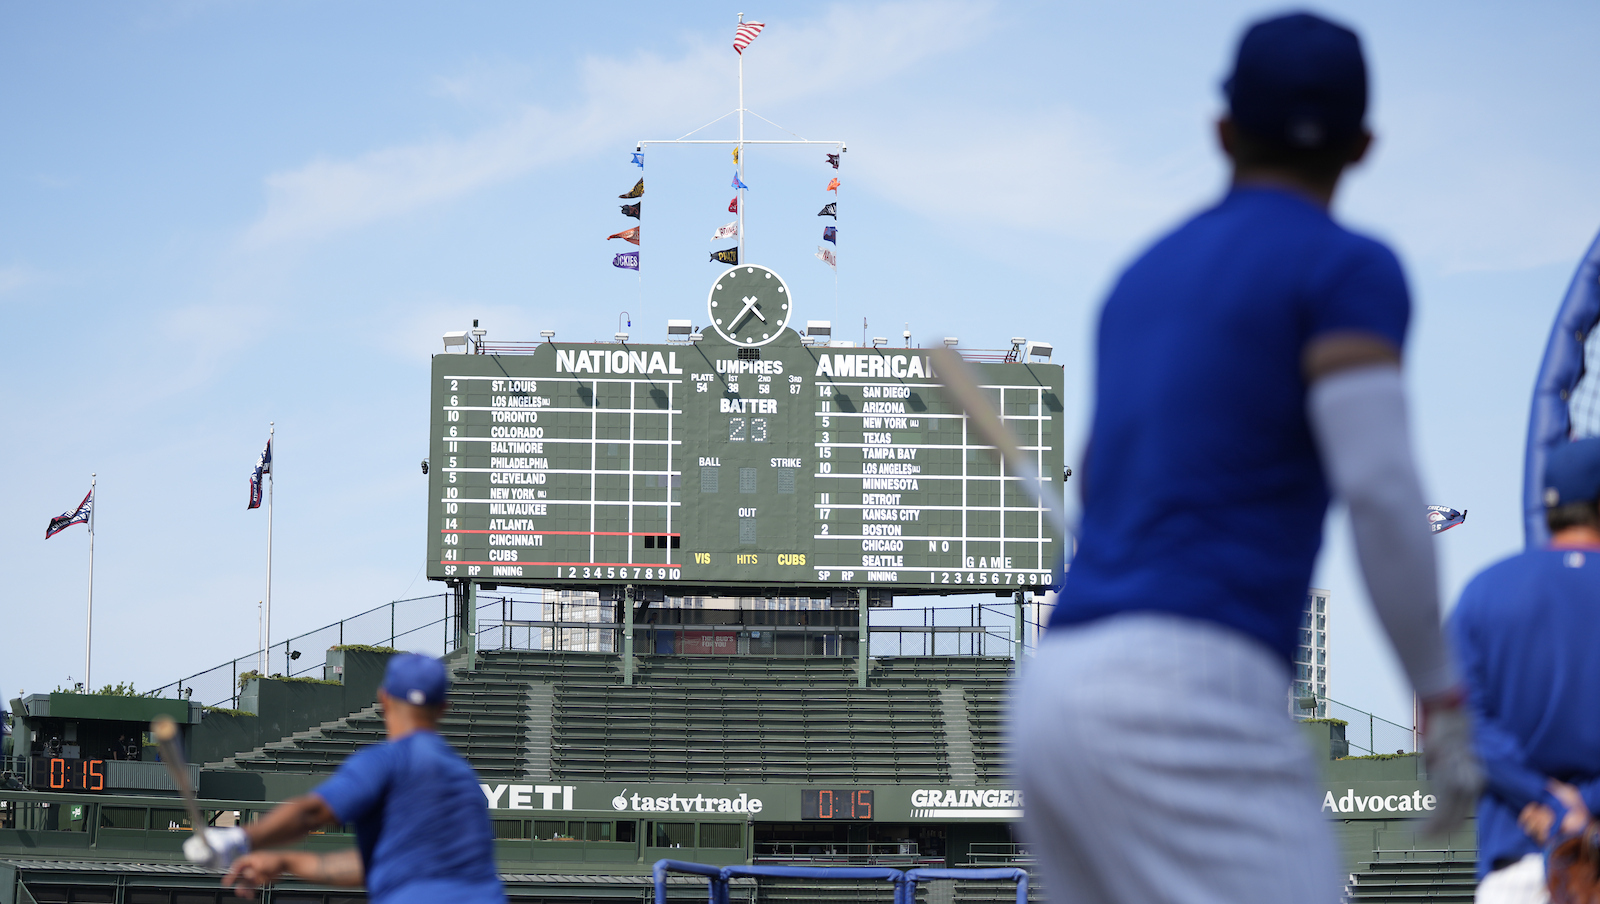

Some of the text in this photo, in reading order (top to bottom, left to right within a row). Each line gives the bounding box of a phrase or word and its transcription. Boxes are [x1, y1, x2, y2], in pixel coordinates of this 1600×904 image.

[556, 350, 683, 374] NATIONAL
[717, 360, 783, 375] UMPIRES
[691, 373, 714, 381] PLATE
[729, 374, 738, 382] 1ST
[789, 375, 802, 383] 3RD
[450, 380, 459, 392] 2
[491, 380, 537, 393] ST. LOUIS
[697, 383, 707, 392] 54
[728, 383, 739, 392] 38
[759, 384, 770, 394] 58
[790, 384, 800, 394] 87
[820, 386, 832, 397] 14
[862, 386, 911, 398] SAN DIEGO
[450, 395, 459, 407] 6
[491, 396, 507, 408] LOS
[508, 396, 542, 408] ANGELES
[720, 398, 777, 413] BATTER
[821, 401, 831, 412] 11
[862, 402, 906, 414] ARIZONA
[447, 411, 460, 423] 10
[491, 411, 538, 423] TORONTO
[821, 417, 830, 428] 5
[862, 417, 883, 429] NEW
[884, 418, 908, 429] YORK
[449, 426, 458, 438] 6
[490, 427, 544, 438] COLORADO
[730, 418, 766, 441] 23
[821, 432, 830, 444] 3
[862, 432, 892, 444] TEXAS
[449, 441, 458, 453] 11
[490, 442, 544, 454] BALTIMORE
[819, 447, 832, 459] 15
[862, 448, 917, 460] TAMPA BAY
[449, 457, 458, 468] 5
[490, 457, 549, 469] PHILADELPHIA
[699, 457, 720, 466] BALL
[771, 458, 801, 467] STRIKE
[819, 462, 832, 474] 10
[862, 463, 878, 474] LOS
[879, 463, 912, 475] ANGELES
[448, 472, 457, 484] 5
[490, 472, 547, 484] CLEVELAND
[862, 478, 919, 491] MINNESOTA
[446, 487, 458, 499] 10
[490, 488, 510, 500] NEW
[511, 488, 535, 500] YORK
[820, 493, 830, 505] 11
[862, 494, 902, 506] DETROIT
[446, 502, 458, 514] 10
[489, 503, 547, 515] MILWAUKEE
[739, 508, 756, 517] OUT
[819, 508, 831, 520] 17
[862, 509, 921, 521] KANSAS CITY
[446, 518, 458, 529] 14
[489, 519, 534, 530] ATLANTA
[821, 524, 829, 535] 2
[862, 524, 902, 536] BOSTON
[444, 534, 458, 545] 40
[489, 534, 542, 546] CINCINNATI
[862, 539, 904, 552] CHICAGO
[444, 549, 458, 561] 41
[488, 549, 519, 562] CUBS
[694, 552, 711, 565] VIS
[736, 554, 758, 565] HITS
[777, 553, 806, 566] CUBS
[862, 555, 904, 567] SEATTLE
[444, 565, 680, 580] SP RP INNING 1 2 3 4 5 6 7 8 9 10
[818, 570, 1053, 585] SP RP INNING 1 2 3 4 5 6 7 8 9 10
[50, 758, 104, 790] 0:15
[481, 784, 574, 811] YETI
[631, 793, 763, 814] tastytrade
[911, 789, 1022, 807] GRAINGER
[1322, 789, 1436, 812] Advocate
[819, 790, 873, 819] 0:15
